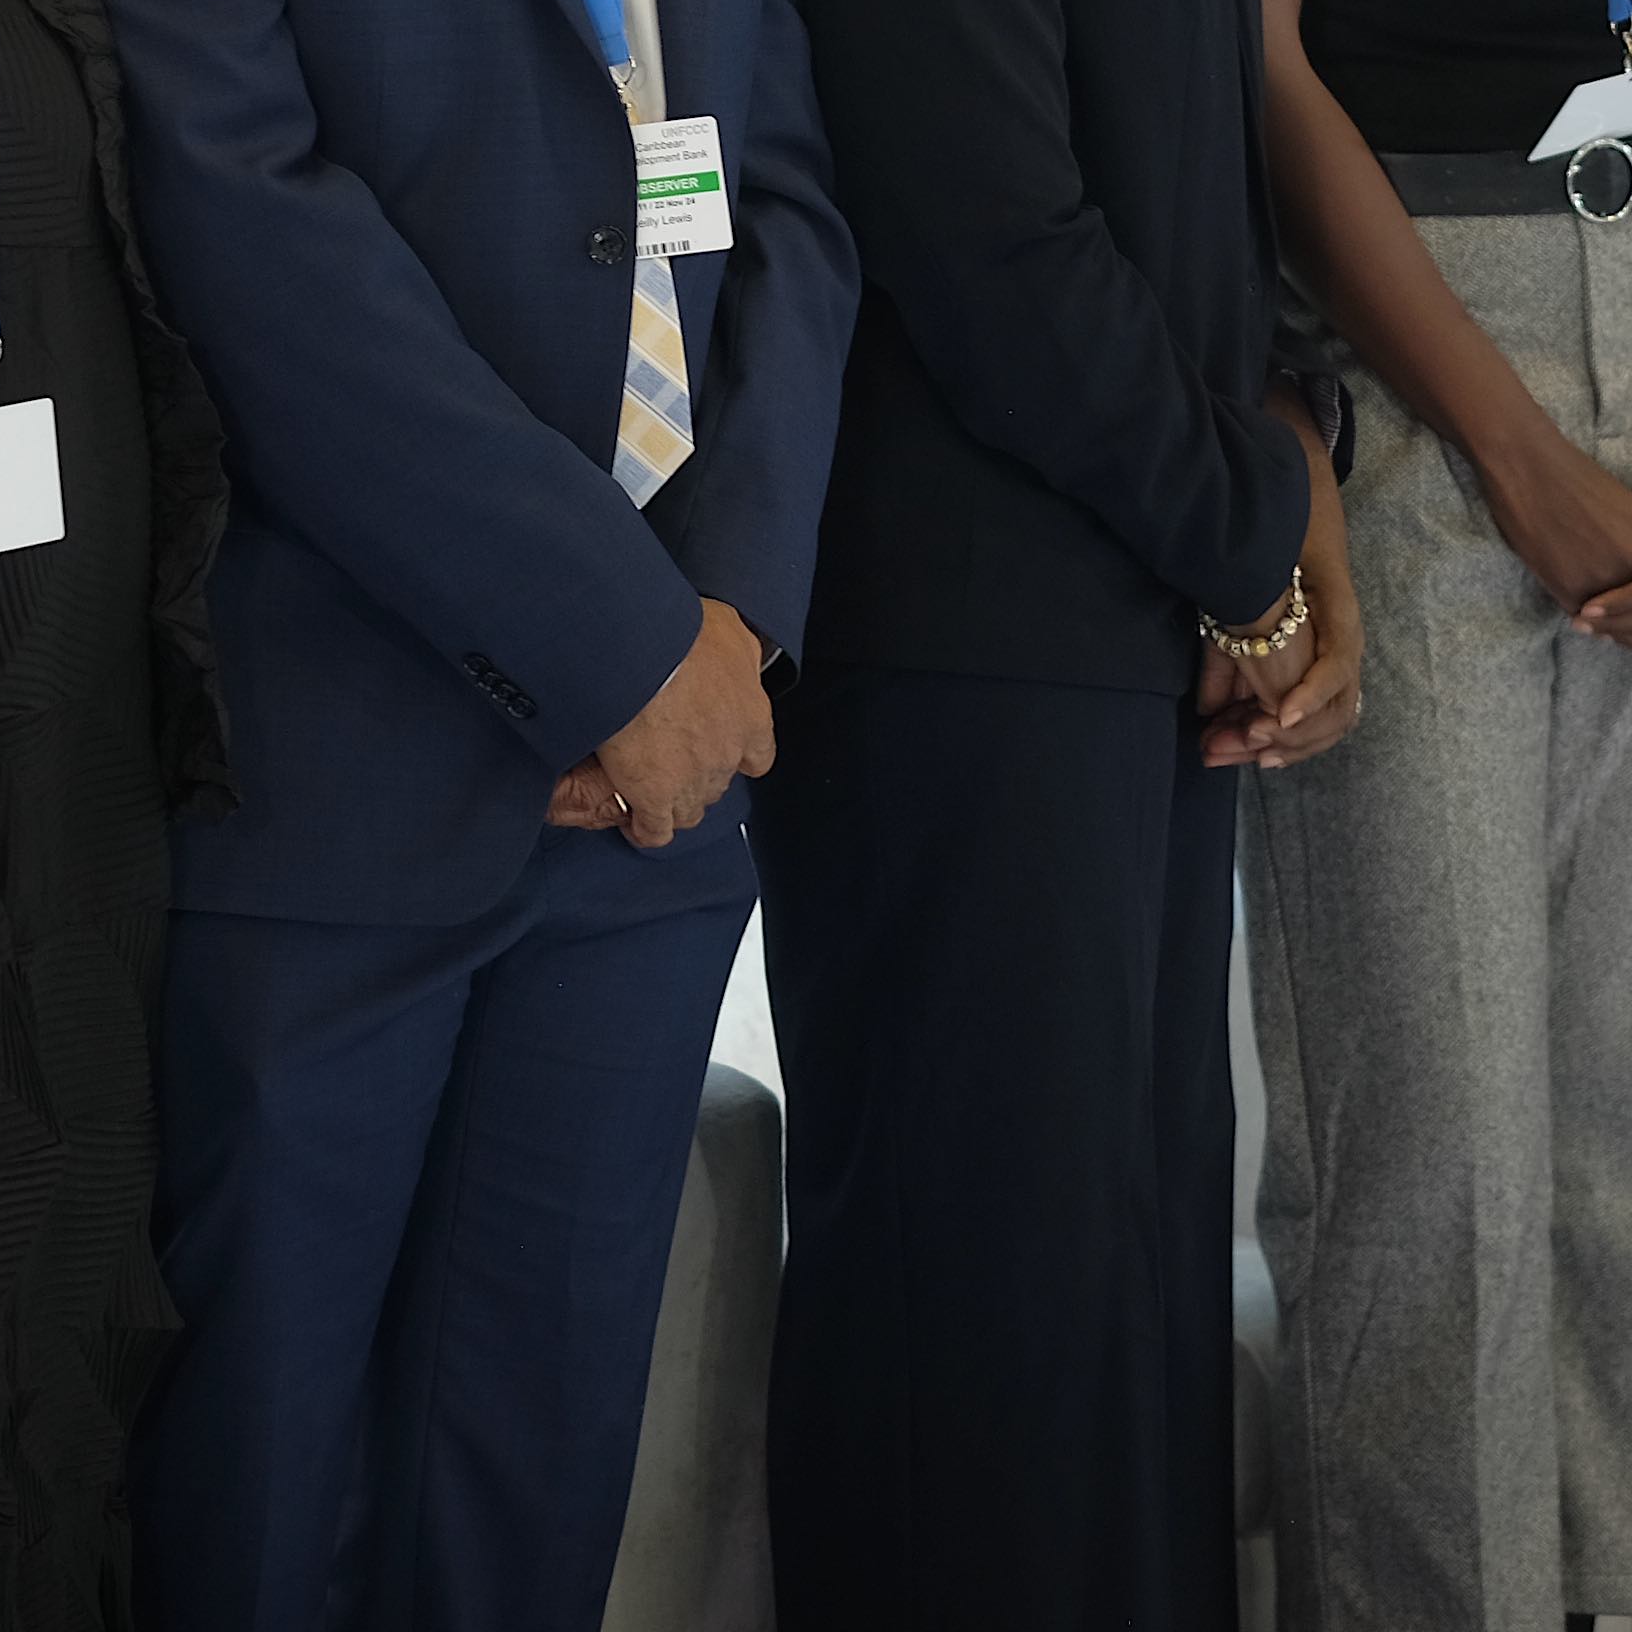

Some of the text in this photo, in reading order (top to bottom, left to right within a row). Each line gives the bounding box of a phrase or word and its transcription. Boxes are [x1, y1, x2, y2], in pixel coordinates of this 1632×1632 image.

[661, 123, 710, 139] UNFCCC
[682, 150, 709, 161] Bank
[662, 214, 693, 226] Lewis
